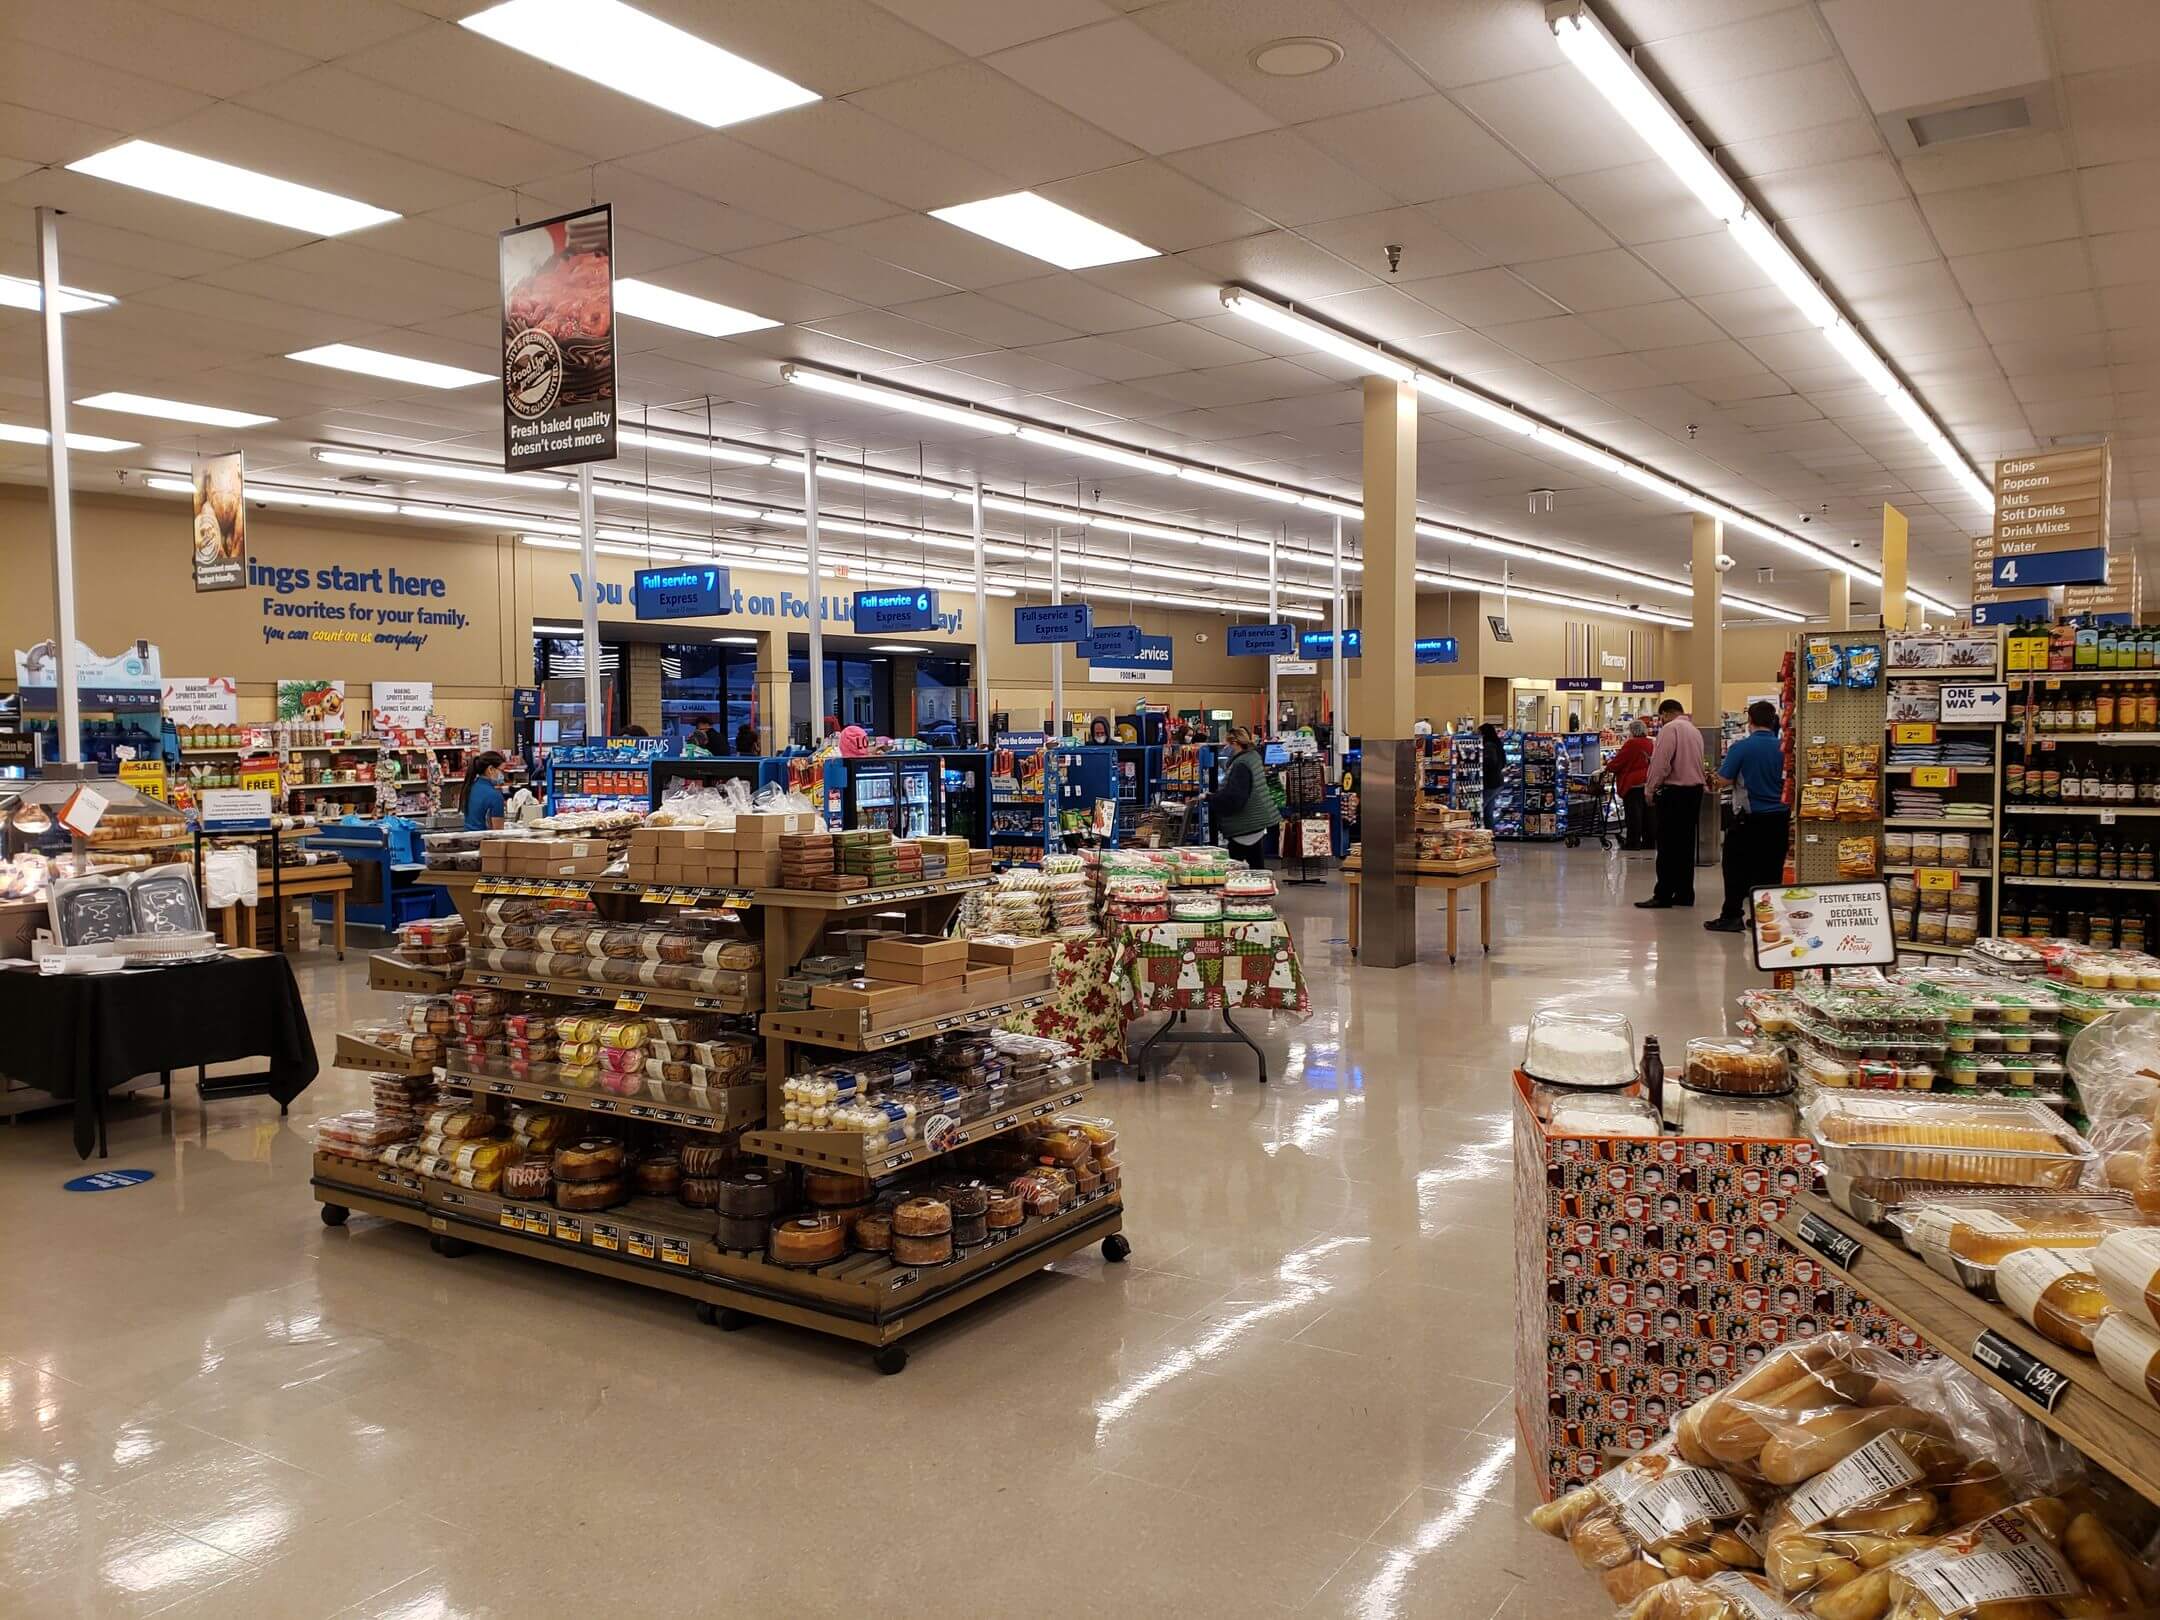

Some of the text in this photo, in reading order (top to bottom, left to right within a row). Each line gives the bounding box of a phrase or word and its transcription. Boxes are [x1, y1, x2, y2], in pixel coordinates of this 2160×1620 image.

[512, 353, 549, 383] Food Lion
[511, 411, 611, 439] Fresh baked quality
[511, 433, 605, 457] doesn't cost more.
[2003, 461, 2036, 474] Chips
[2003, 475, 2050, 490] Popcorn
[2002, 494, 2030, 505] Nuts
[2002, 505, 2066, 521] Soft Drinks
[2002, 521, 2071, 537] Drink Mixes
[2001, 542, 2037, 553] Water
[249, 557, 446, 597] ings start here
[2000, 560, 2018, 583] 4
[642, 573, 698, 591] Full service
[704, 571, 715, 592] 7
[659, 593, 698, 607] Express
[748, 595, 776, 616] on
[861, 594, 912, 608] Full service
[917, 594, 928, 611] 6
[263, 597, 470, 629] Favorites for your family.
[876, 611, 912, 623] Express
[1022, 610, 1068, 622] Full service
[1074, 610, 1083, 624] 5
[1975, 607, 1986, 623] 5
[1035, 625, 1069, 635] Express
[1233, 629, 1275, 638] Full service
[1280, 629, 1288, 639] 3
[287, 629, 308, 640] can
[312, 628, 344, 642] count
[361, 631, 373, 645] us
[374, 631, 428, 651] everyday!
[1094, 641, 1121, 651] Express
[1245, 640, 1274, 648] Express
[1304, 635, 1318, 644] Full
[1349, 634, 1357, 645] 2
[1446, 641, 1452, 651] 1
[1601, 650, 1626, 670] Pharmacy
[1947, 689, 1975, 698] ONE
[1946, 700, 1977, 709] WAY
[607, 738, 669, 752] NEW ITEMS
[135, 763, 161, 771] SALE!
[247, 779, 275, 791] FREE
[1819, 892, 1882, 904] FESTIVE TREATS
[1830, 907, 1873, 919] DECORATE
[1825, 917, 1880, 928] WITH FAMILY
[1829, 1234, 1853, 1255] 3.49
[2024, 1363, 2057, 1390] 1.99
[1870, 1475, 1887, 1490] 210
[2025, 1575, 2041, 1594] 210
